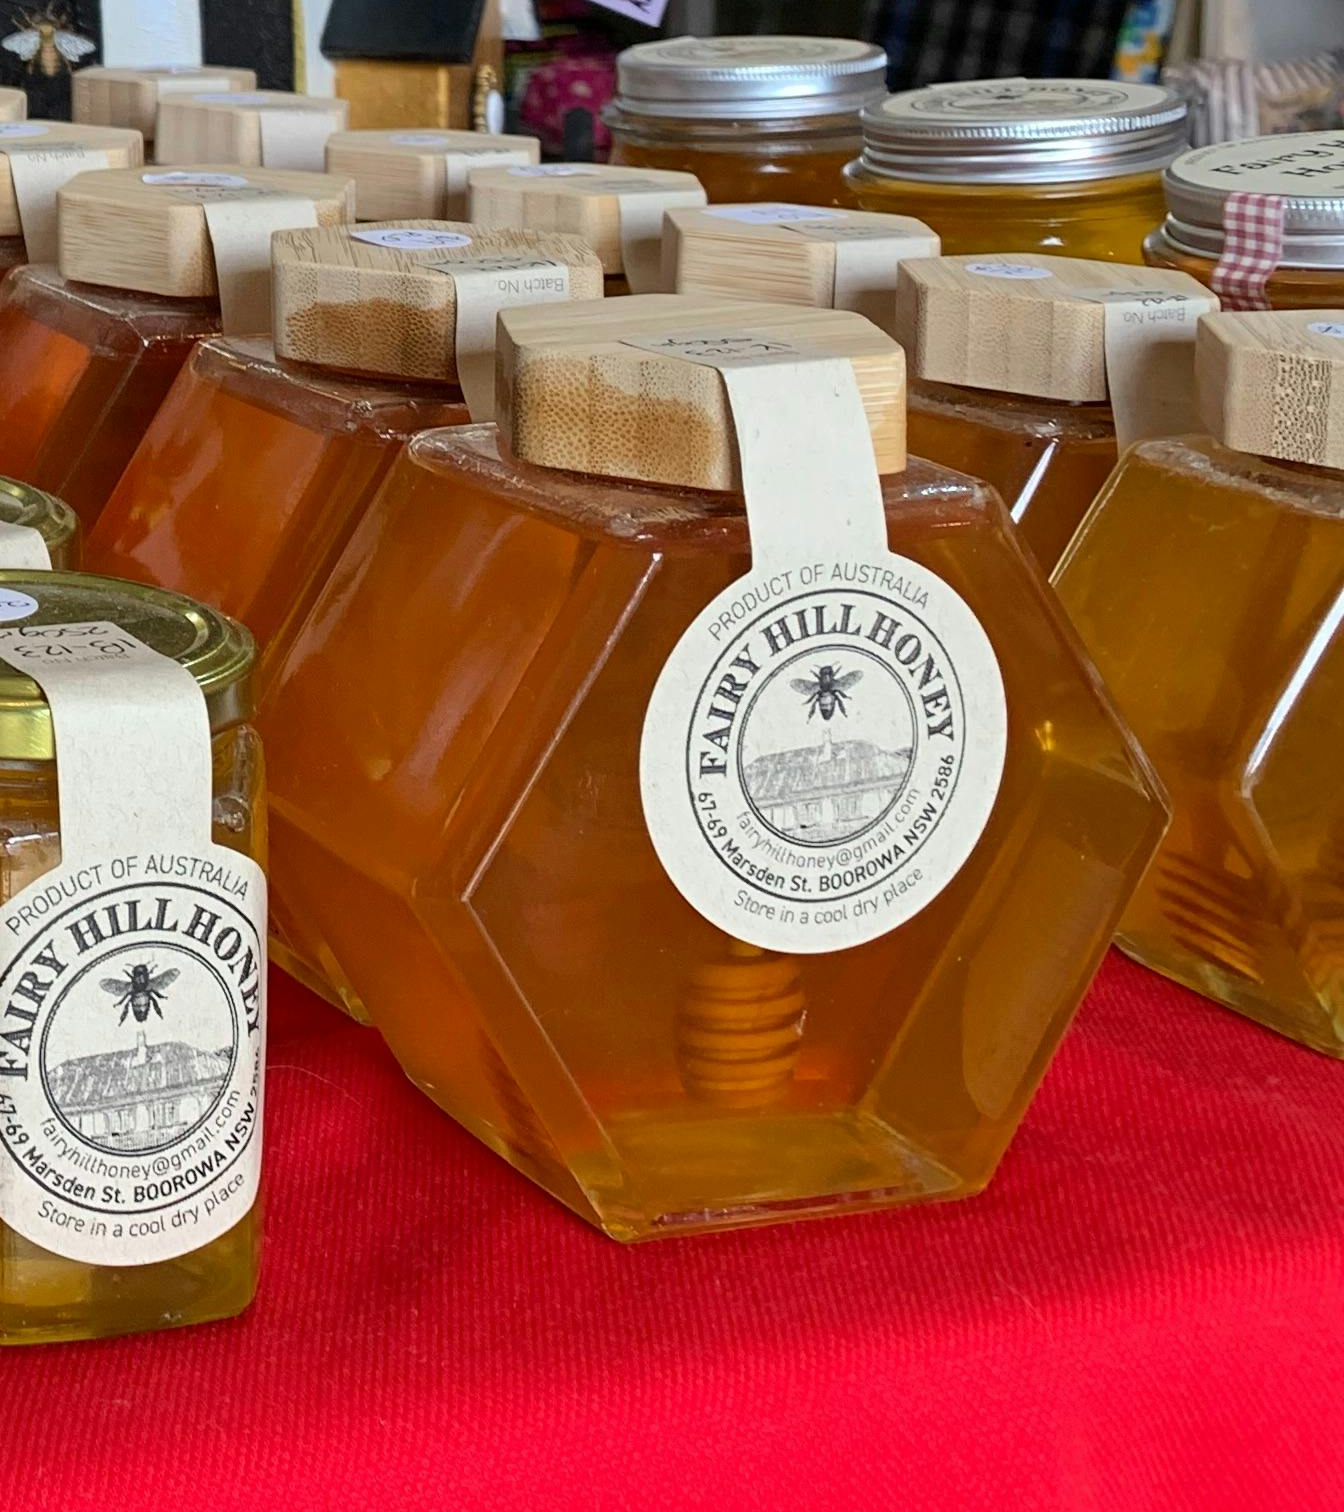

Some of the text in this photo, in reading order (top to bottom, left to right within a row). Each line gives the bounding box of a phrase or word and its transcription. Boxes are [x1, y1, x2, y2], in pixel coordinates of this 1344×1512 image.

[1210, 149, 1334, 176] Fairy
[524, 278, 564, 293] Batch
[1148, 308, 1185, 325] Batch
[708, 563, 930, 641] PRODUCT OF AUSTRALIA
[699, 603, 955, 779] FAIRY HILL HONEY
[698, 754, 955, 895] 67-69 Marsden St. BOOROWA NSW 2586
[735, 786, 920, 871] fairyhillhoney@gmail.com
[5, 854, 250, 936] PRODUCT OF AUSTRALIA
[732, 867, 925, 925] Store in a cool dry place
[64, 897, 179, 955] HILL
[182, 903, 260, 1038] HONEY
[22, 1145, 96, 1202] Marsden
[101, 1183, 126, 1204] St.
[132, 1151, 227, 1204] BOOROWA
[225, 1104, 255, 1154] NSW
[40, 1088, 241, 1180] fairyhillhoney@gmail.com
[38, 1173, 246, 1240] Store in a cool dry place
